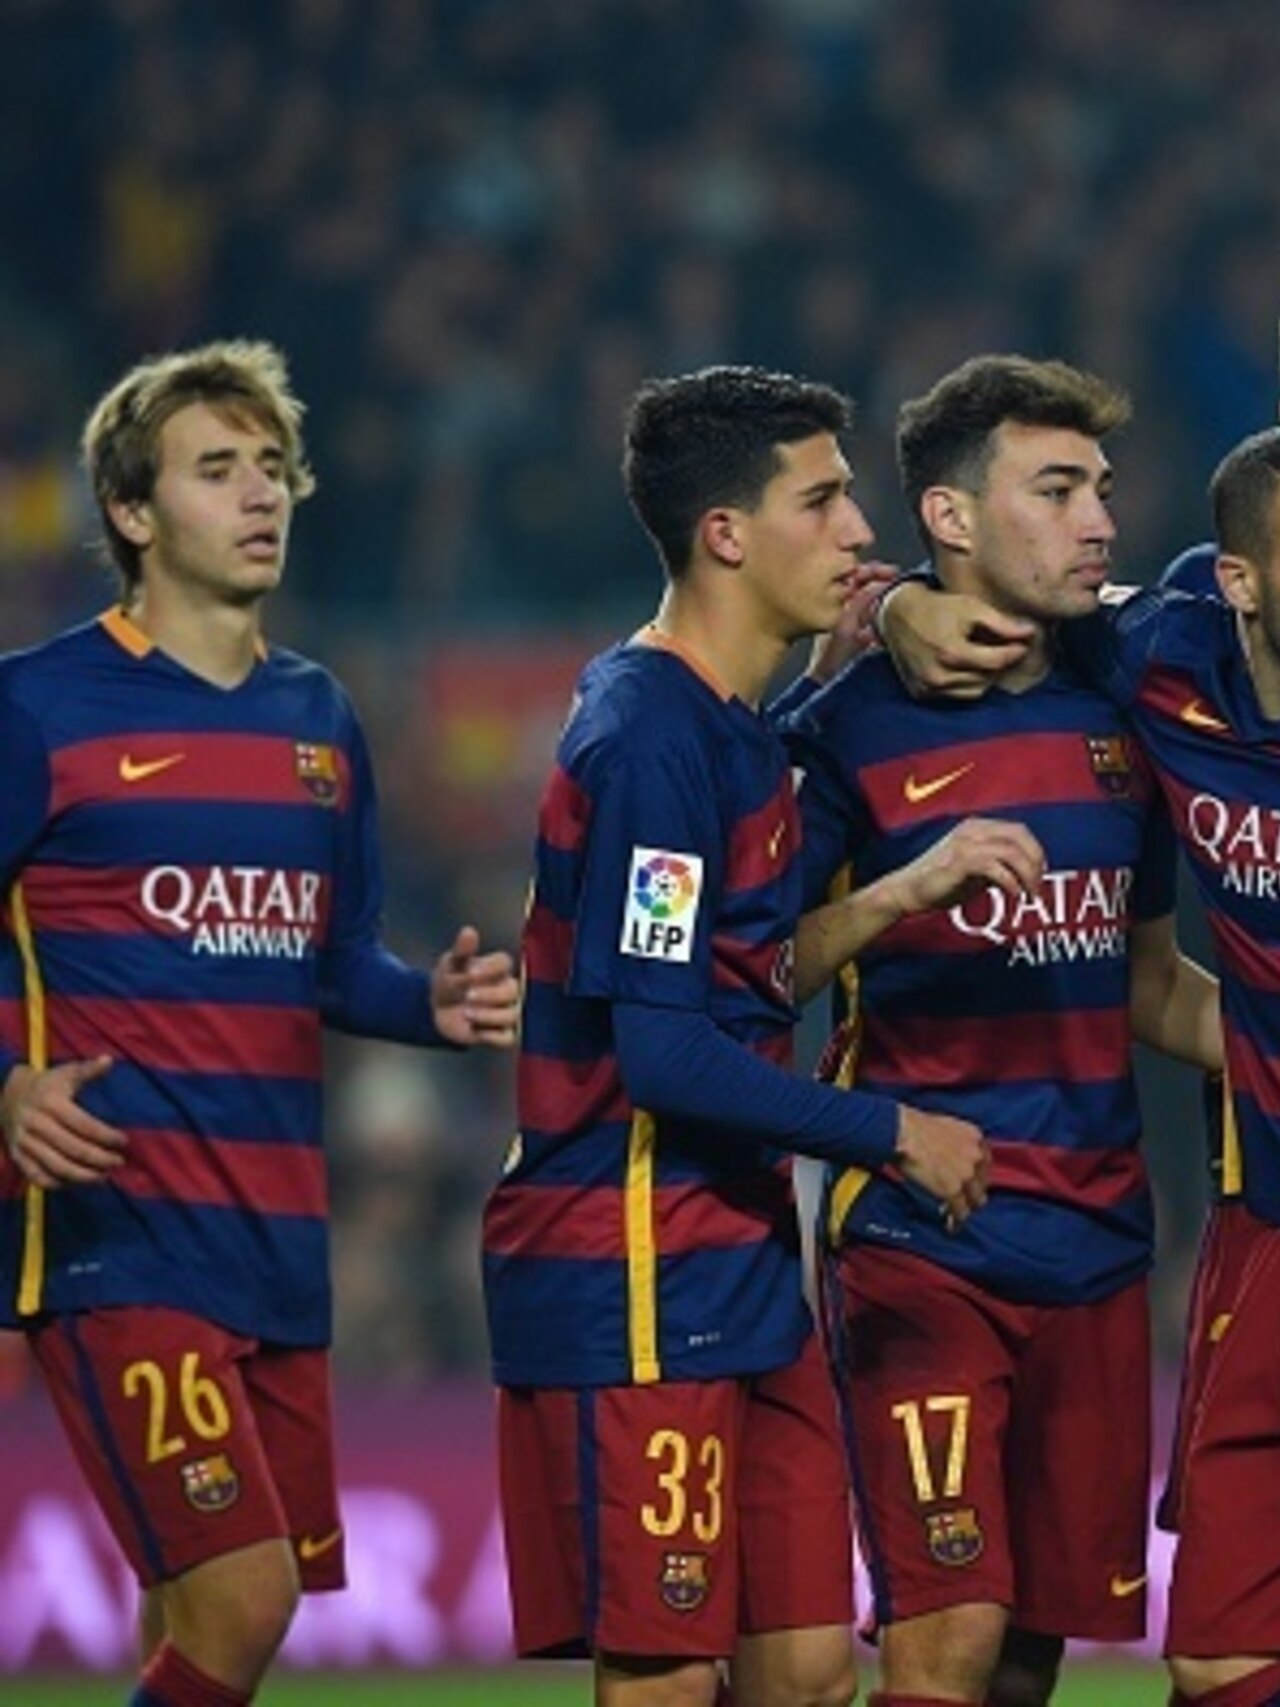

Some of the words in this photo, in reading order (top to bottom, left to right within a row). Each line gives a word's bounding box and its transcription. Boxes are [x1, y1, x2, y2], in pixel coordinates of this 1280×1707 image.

[141, 864, 320, 931] QATAR
[629, 918, 685, 955] LFP
[949, 866, 1134, 945] QATAR
[191, 921, 313, 960] AIRWAY
[124, 1352, 231, 1464] 26
[641, 1429, 723, 1543] 33
[891, 1395, 971, 1501] 17
